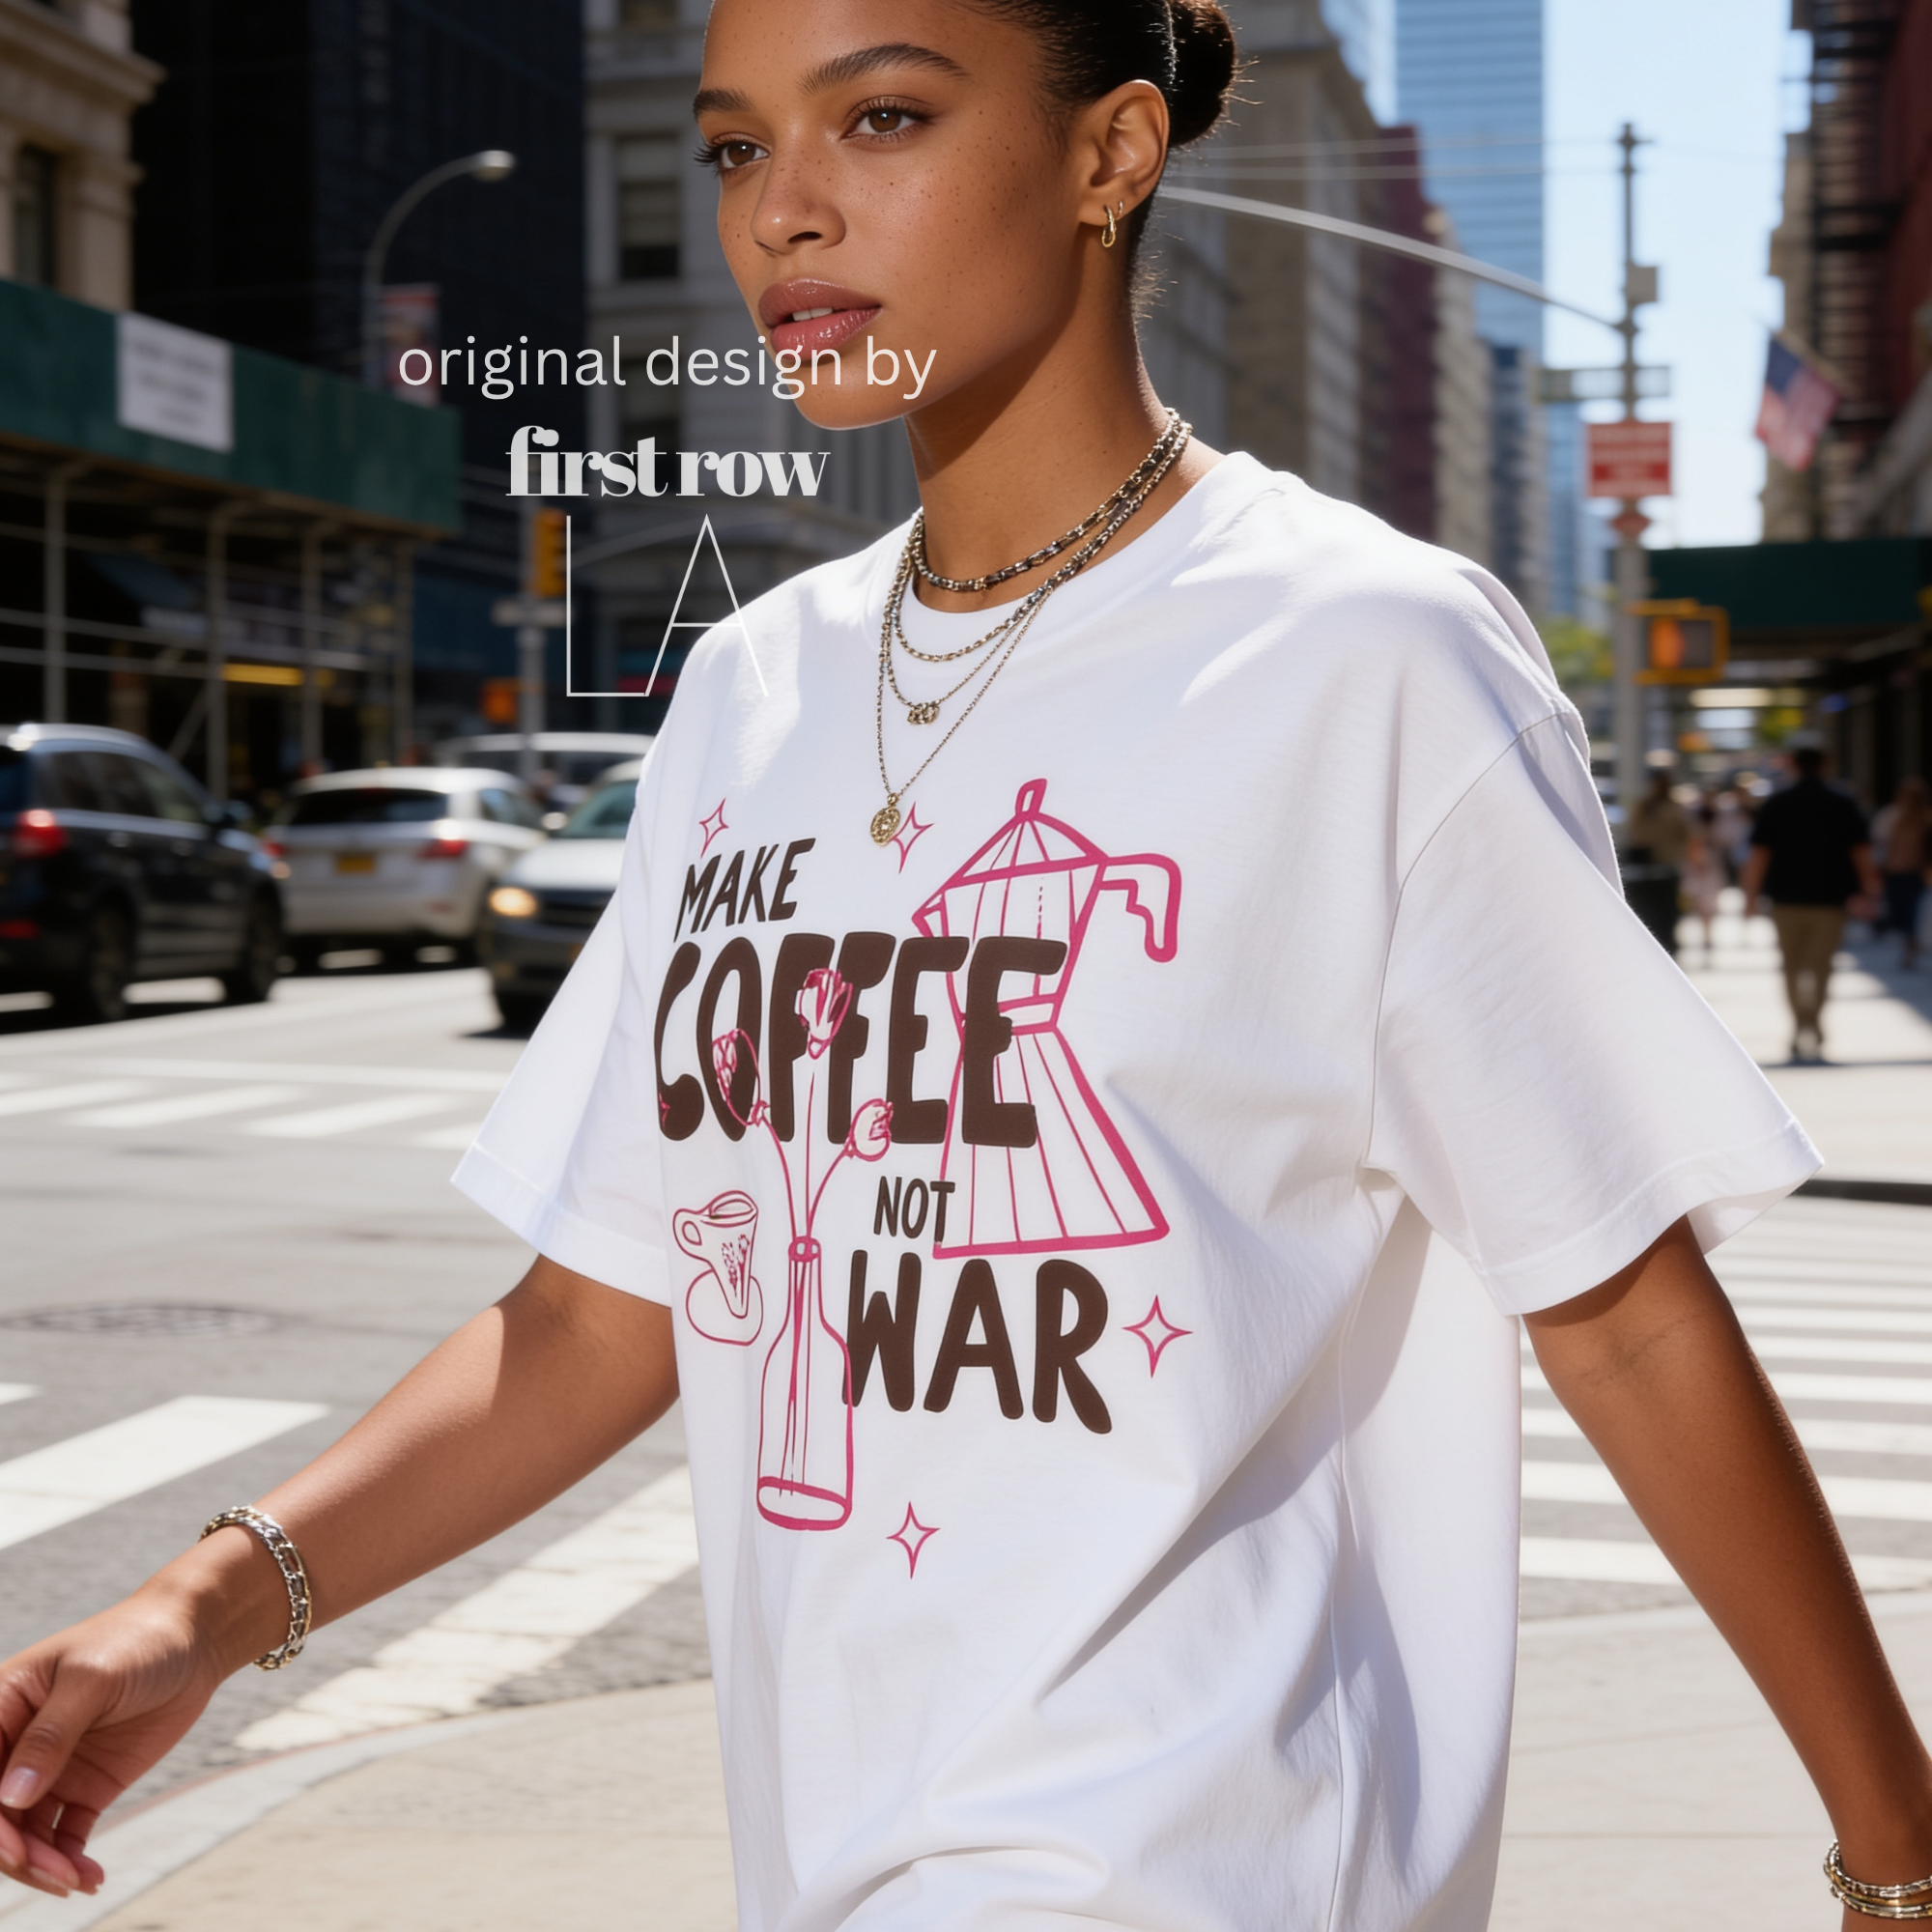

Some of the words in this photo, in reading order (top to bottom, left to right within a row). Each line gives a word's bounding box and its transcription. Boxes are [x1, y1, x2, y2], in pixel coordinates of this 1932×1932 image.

[673, 838, 816, 943] MAKE
[654, 931, 1068, 1149] COFFEE
[873, 1176, 956, 1243] NOT
[841, 1249, 1113, 1435] WAR
